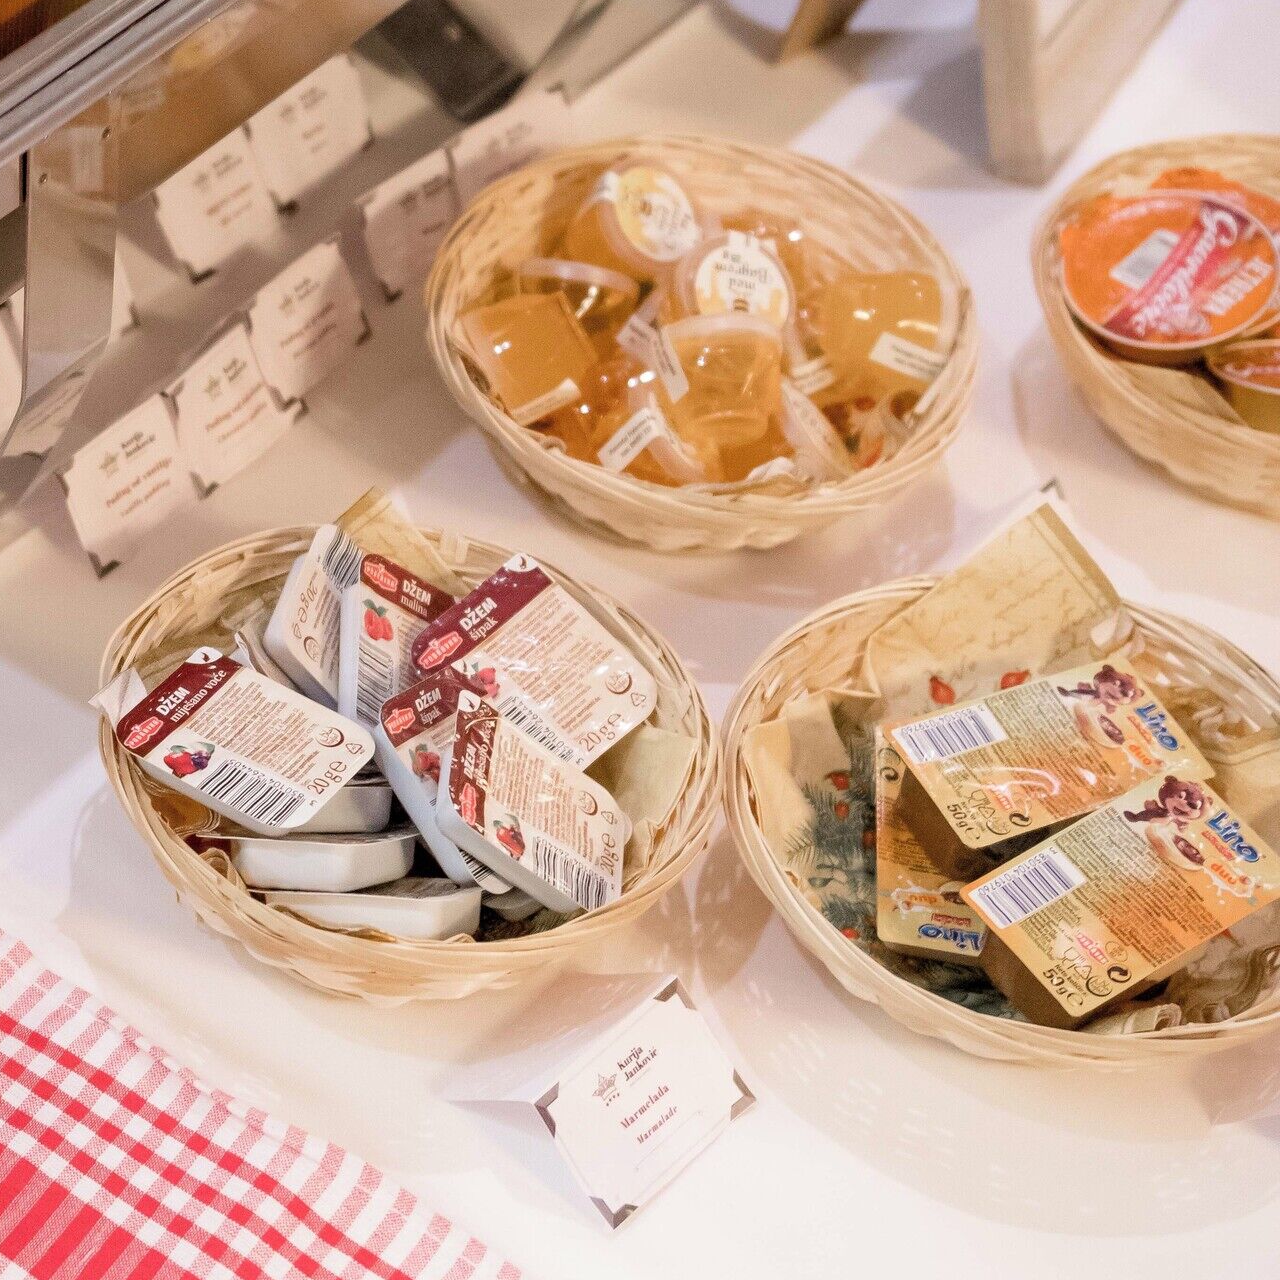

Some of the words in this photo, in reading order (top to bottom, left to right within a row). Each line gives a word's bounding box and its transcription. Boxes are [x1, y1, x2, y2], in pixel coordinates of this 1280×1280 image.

[402, 578, 432, 606] DŽEM
[459, 596, 498, 631] DŽEM
[468, 615, 499, 642] šipak
[156, 685, 192, 718] DŽEM
[169, 685, 209, 724] miješano
[204, 668, 228, 695] voće
[415, 687, 442, 713] DŽEM
[1133, 701, 1180, 752] Lino
[463, 743, 478, 780] DŽEM
[1128, 743, 1152, 766] duo
[1204, 809, 1261, 864] Lino
[1210, 862, 1238, 886] duo
[917, 923, 983, 952] Lino
[616, 1046, 644, 1072] Kurija
[624, 1046, 659, 1082] Janković
[619, 1083, 671, 1130] Marmelada
[635, 1105, 678, 1145] Marmalade
